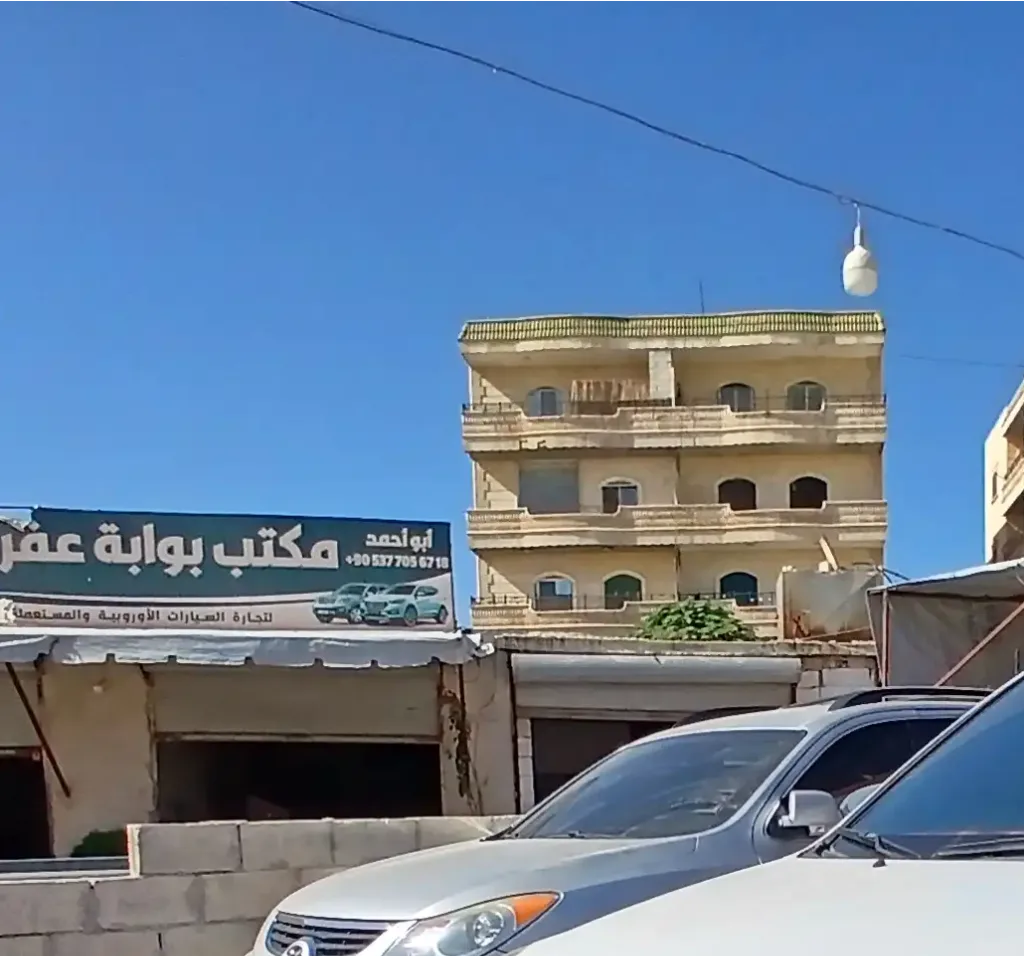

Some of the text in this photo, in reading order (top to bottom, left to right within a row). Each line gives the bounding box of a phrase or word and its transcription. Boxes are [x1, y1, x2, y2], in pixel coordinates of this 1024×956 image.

[94, 522, 204, 578] بوابة
[213, 524, 339, 578] مكتب
[99, 607, 160, 624] الأوروبية
[167, 610, 225, 624] السيارات
[233, 611, 272, 625] لتجارة
